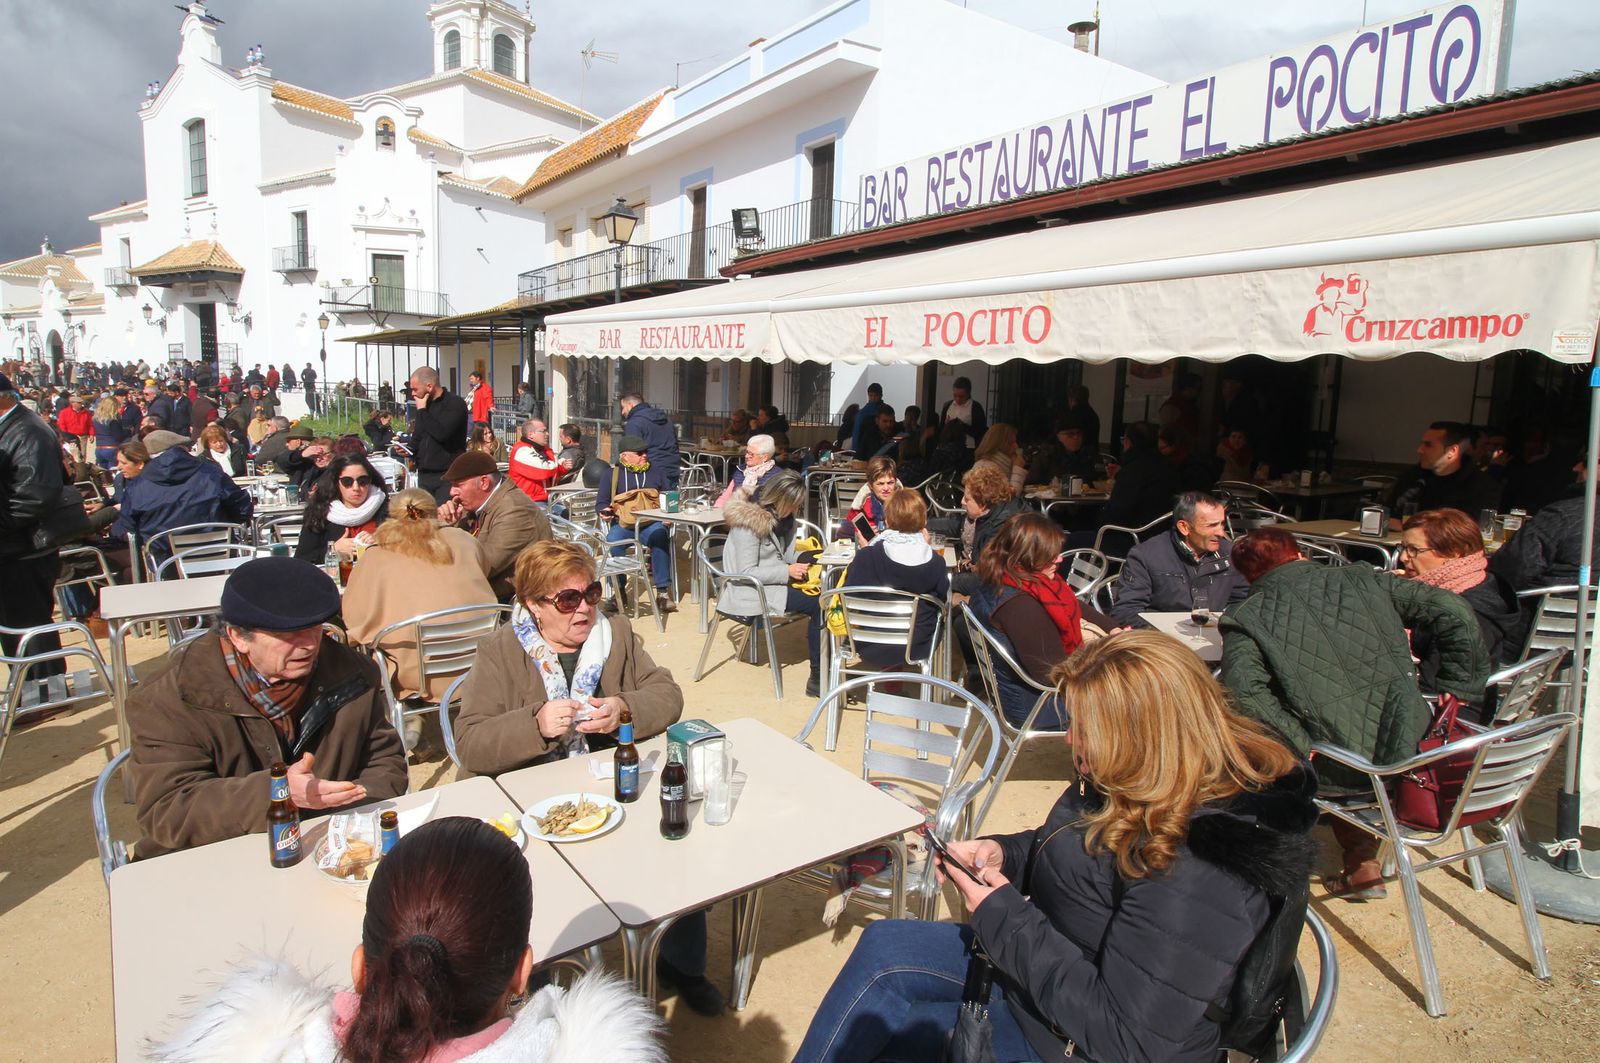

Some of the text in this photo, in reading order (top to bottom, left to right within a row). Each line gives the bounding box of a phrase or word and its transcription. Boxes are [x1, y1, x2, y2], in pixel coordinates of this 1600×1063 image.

[864, 4, 1482, 228] BAR RESTAURANTE EL POCITO
[599, 323, 746, 349] BAR RESTAURANTE
[863, 305, 1051, 348] EL POCITO
[1345, 313, 1524, 343] Cruzcampo
